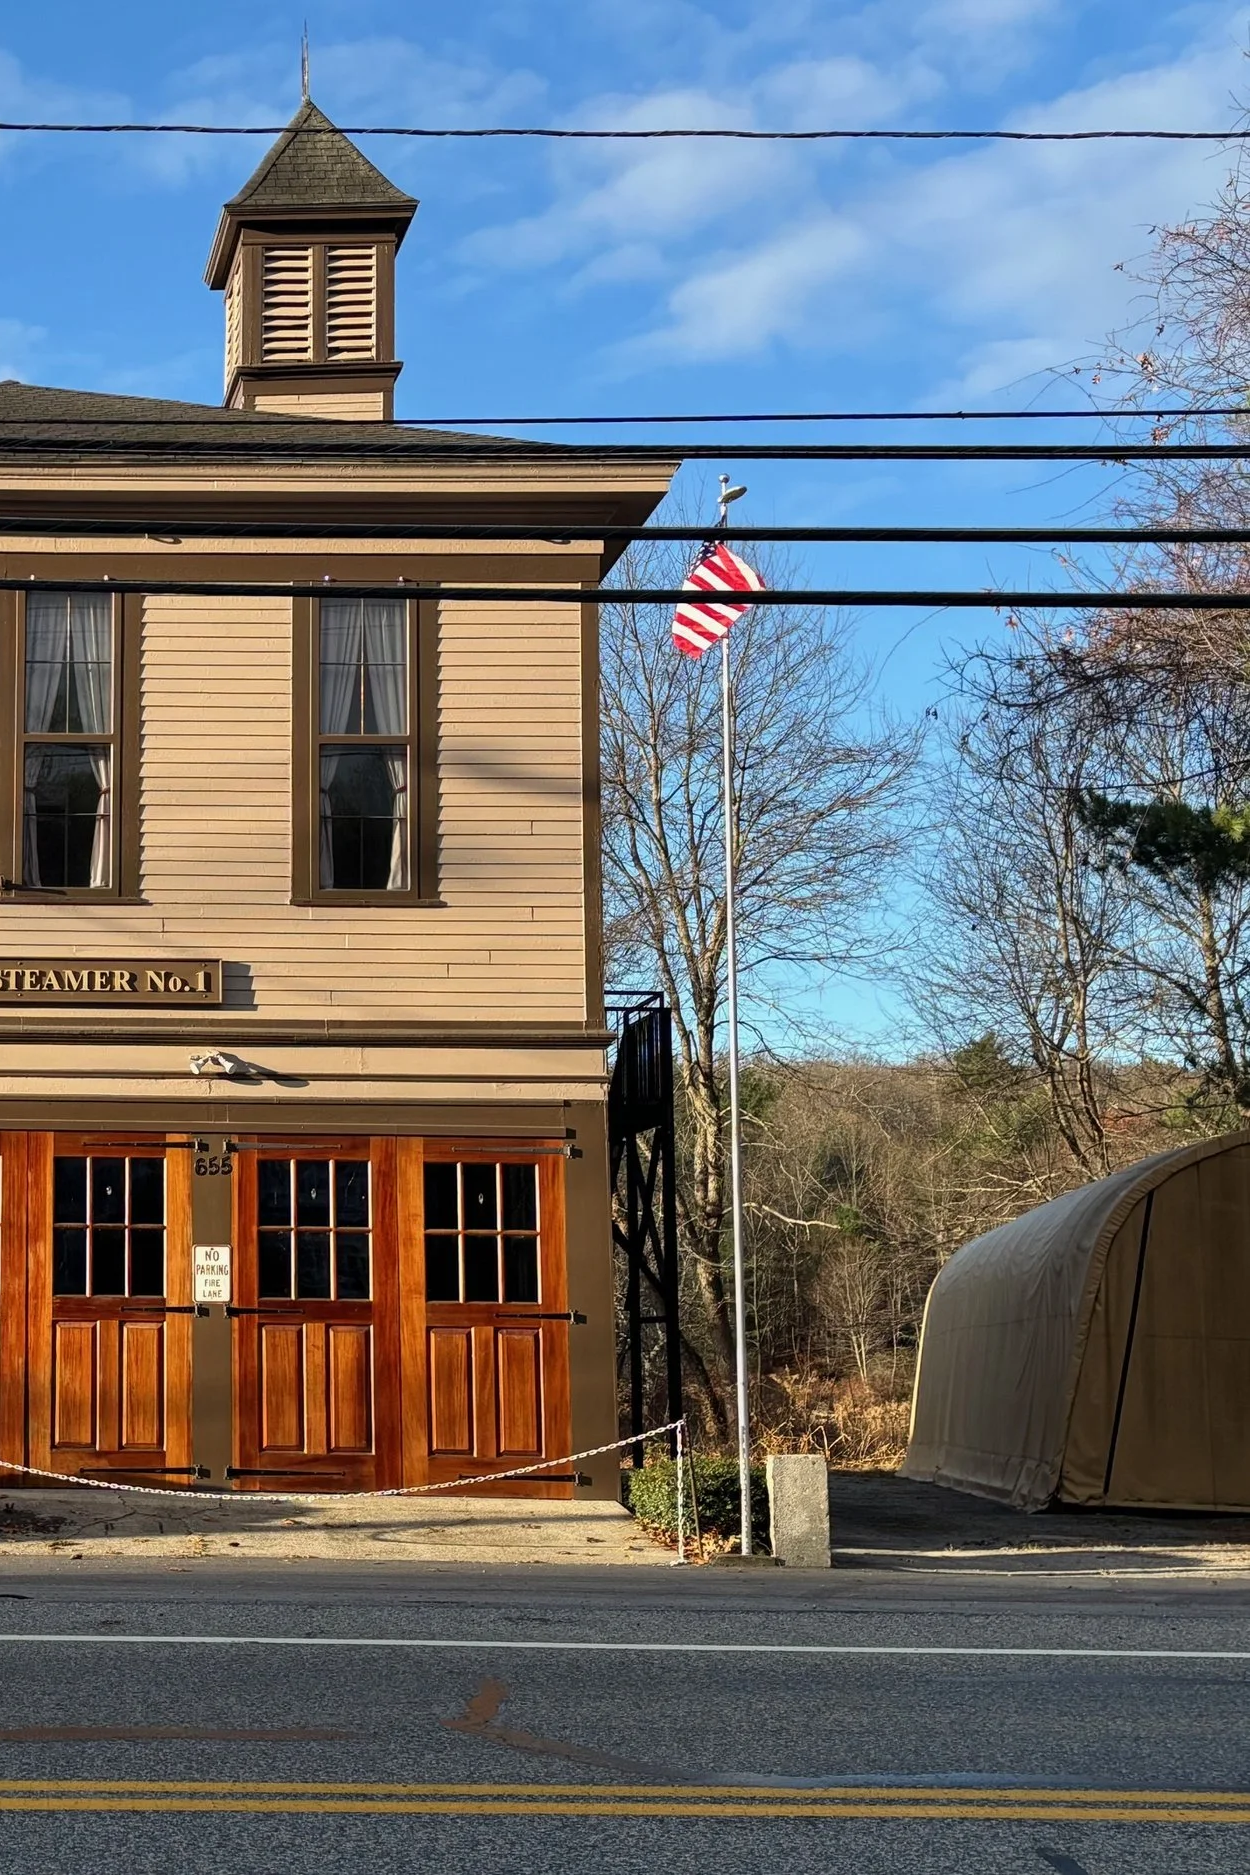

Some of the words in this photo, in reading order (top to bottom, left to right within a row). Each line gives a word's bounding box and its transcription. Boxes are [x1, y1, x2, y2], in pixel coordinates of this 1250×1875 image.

[195, 1156, 233, 1176] 655
[205, 1250, 220, 1262] NO
[196, 1264, 229, 1276] PARKING
[204, 1278, 221, 1288] FIRE
[203, 1289, 222, 1298] LANE
